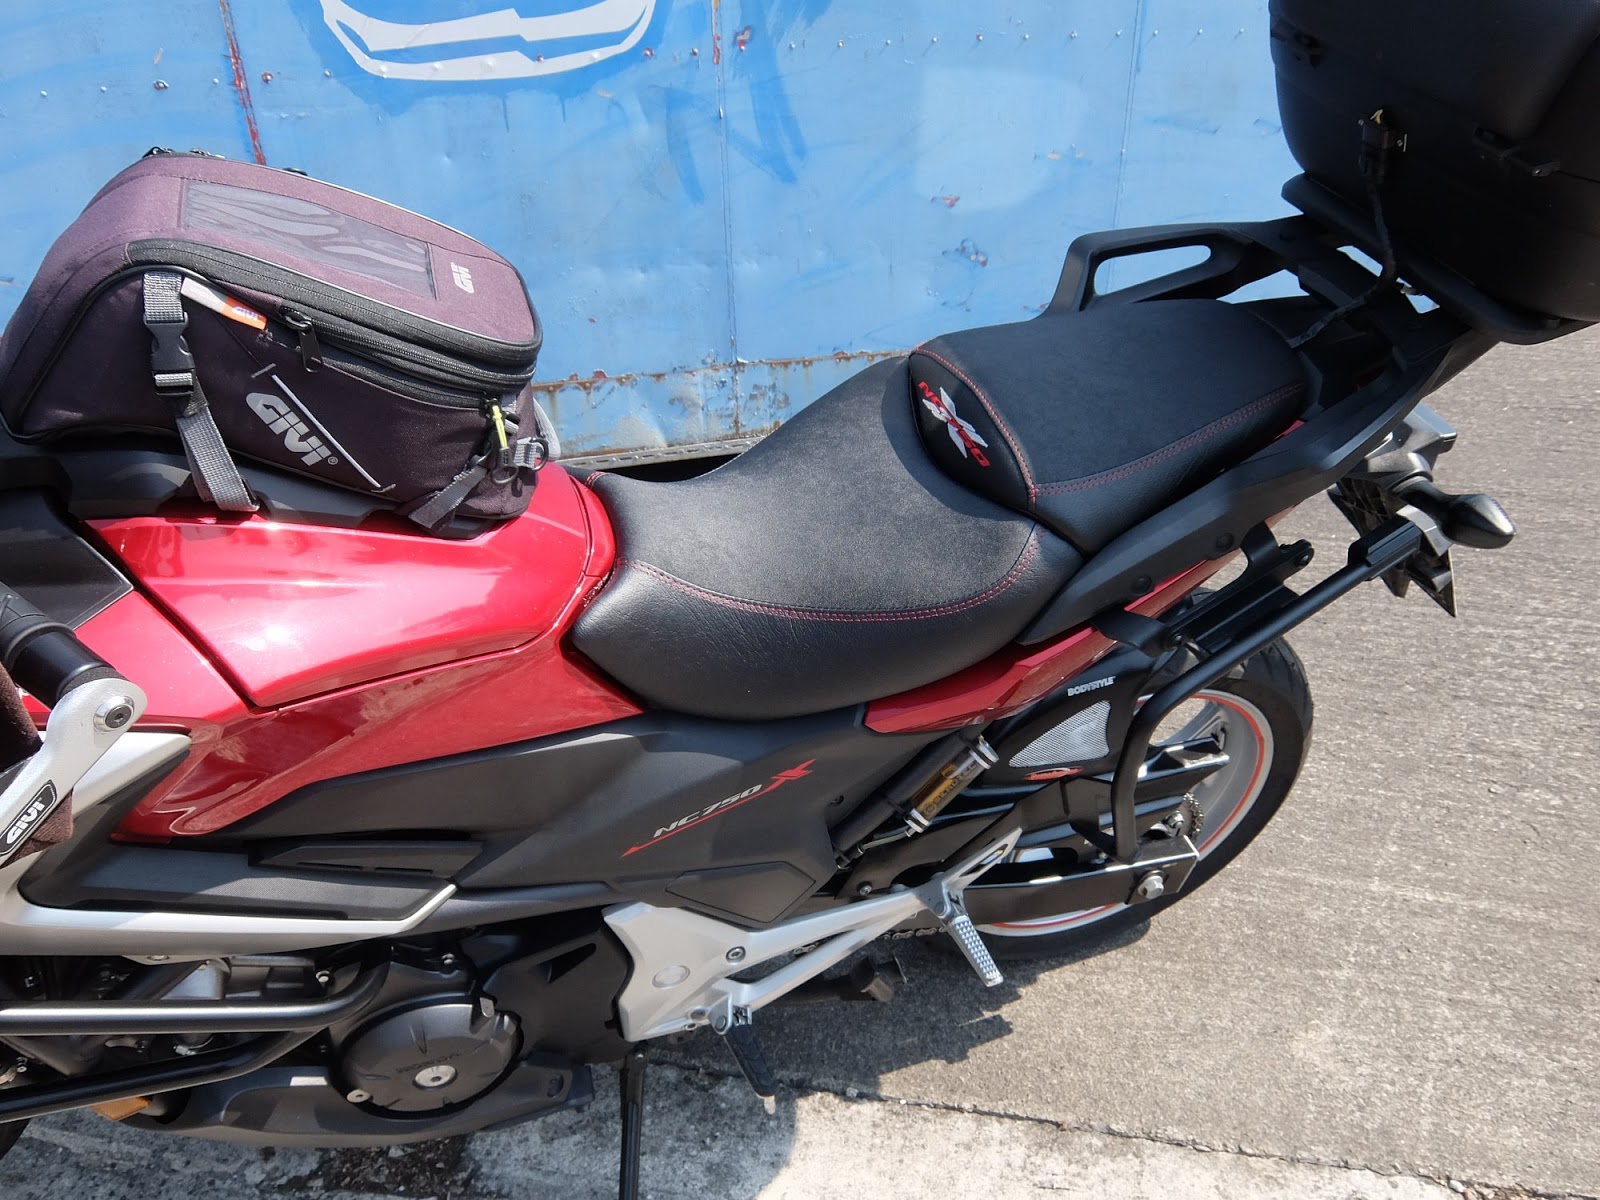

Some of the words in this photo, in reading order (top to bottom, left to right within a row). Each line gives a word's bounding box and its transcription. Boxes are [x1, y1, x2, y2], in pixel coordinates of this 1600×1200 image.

[450, 261, 475, 294] GIVI
[245, 392, 332, 466] GIVI
[1067, 676, 1115, 697] BODYSTYLE
[6, 799, 46, 845] GIVI
